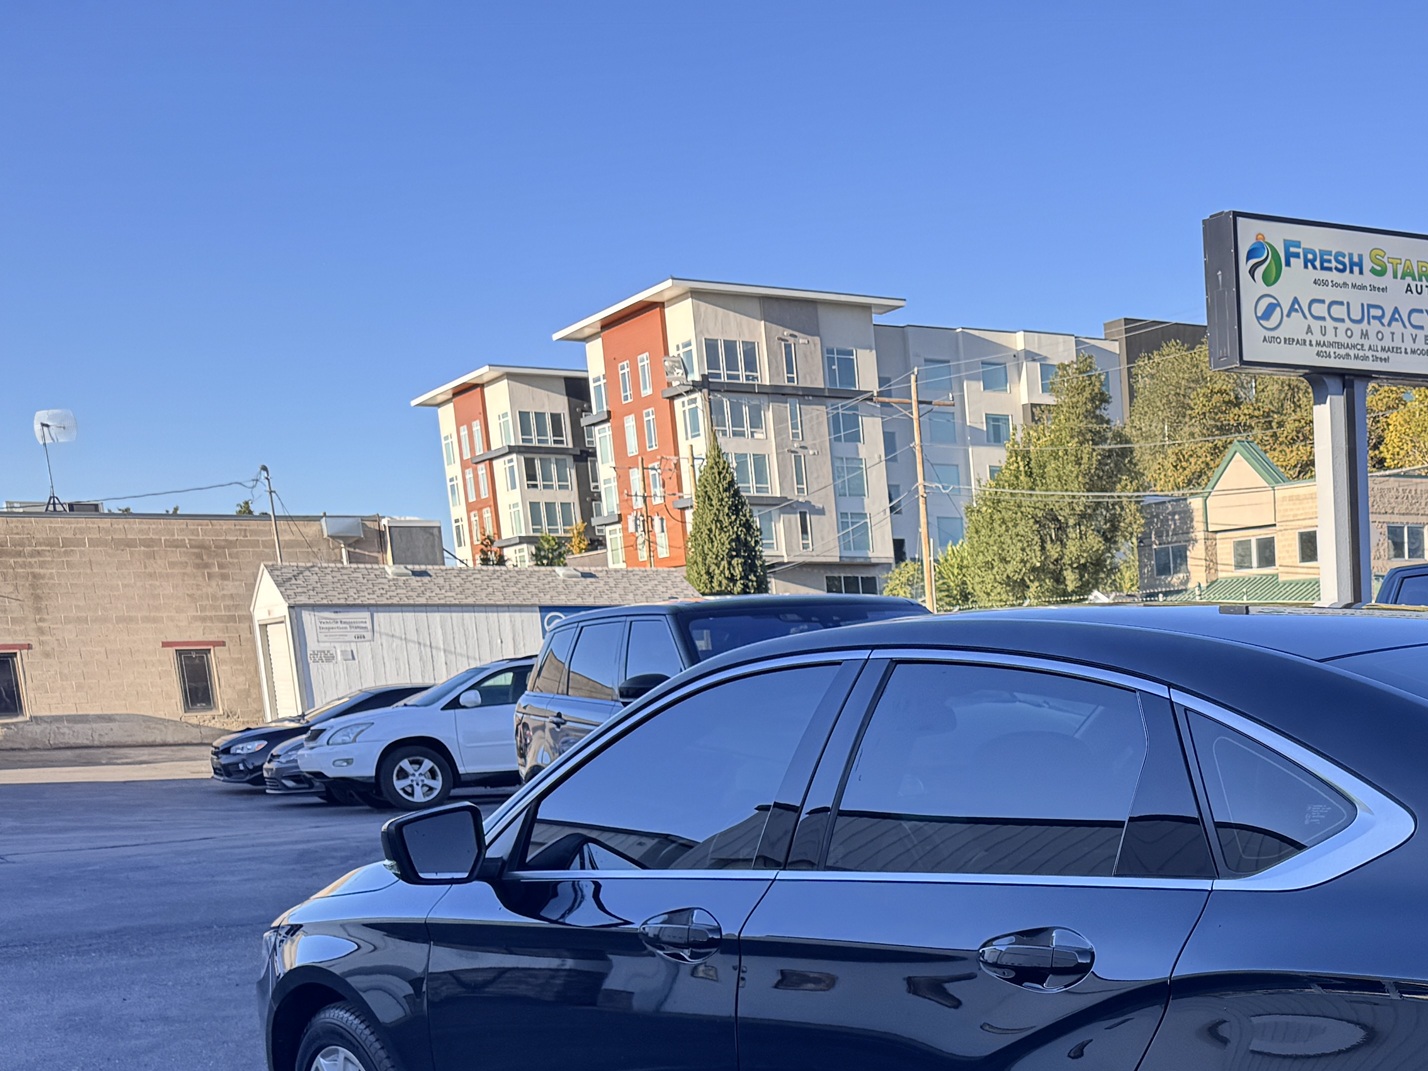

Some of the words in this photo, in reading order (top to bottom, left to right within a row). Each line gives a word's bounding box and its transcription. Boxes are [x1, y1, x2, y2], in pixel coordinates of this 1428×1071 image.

[1283, 238, 1364, 276] FRESH
[1312, 278, 1330, 288] 4050
[1330, 279, 1350, 290] South
[1351, 282, 1368, 291] Main
[1368, 283, 1388, 293] Street
[1262, 335, 1282, 345] AUTO
[1283, 336, 1308, 347] REPAIR
[1308, 339, 1314, 347] &
[1367, 343, 1379, 353] ALL
[1380, 345, 1403, 355] MAKES
[1315, 349, 1332, 359] 4036
[1333, 351, 1352, 361] South
[1353, 352, 1370, 362] Main
[1371, 354, 1390, 364] Street
